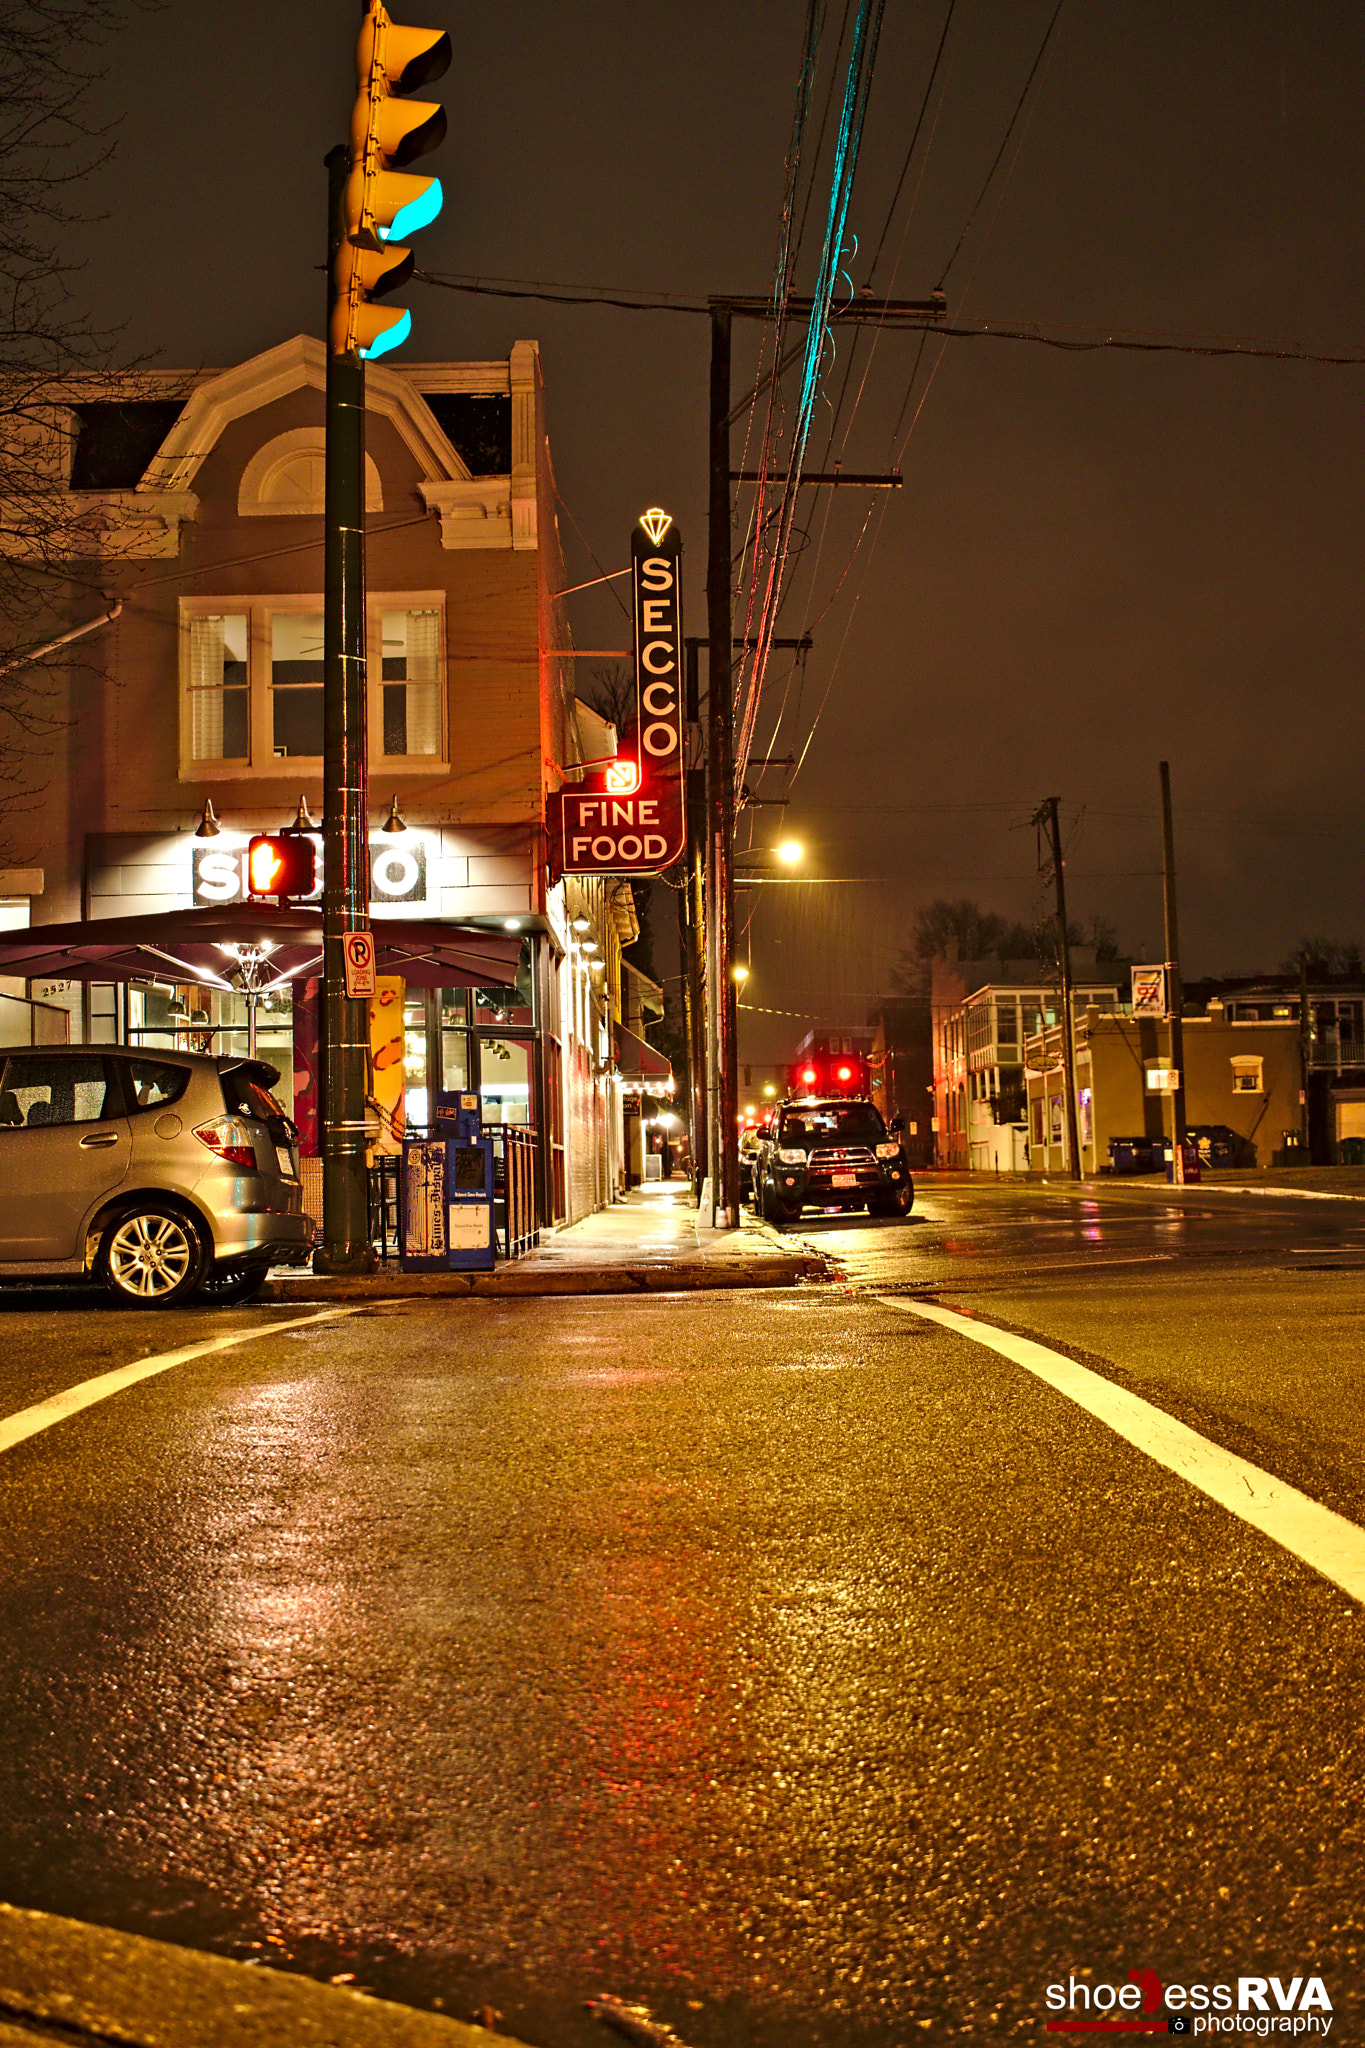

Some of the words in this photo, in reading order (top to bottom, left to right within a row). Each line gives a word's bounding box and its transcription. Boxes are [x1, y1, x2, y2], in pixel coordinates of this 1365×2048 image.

[641, 557, 678, 757] SECCO
[579, 800, 660, 827] FINE
[572, 834, 668, 861] FOOD
[43, 980, 72, 997] 2527
